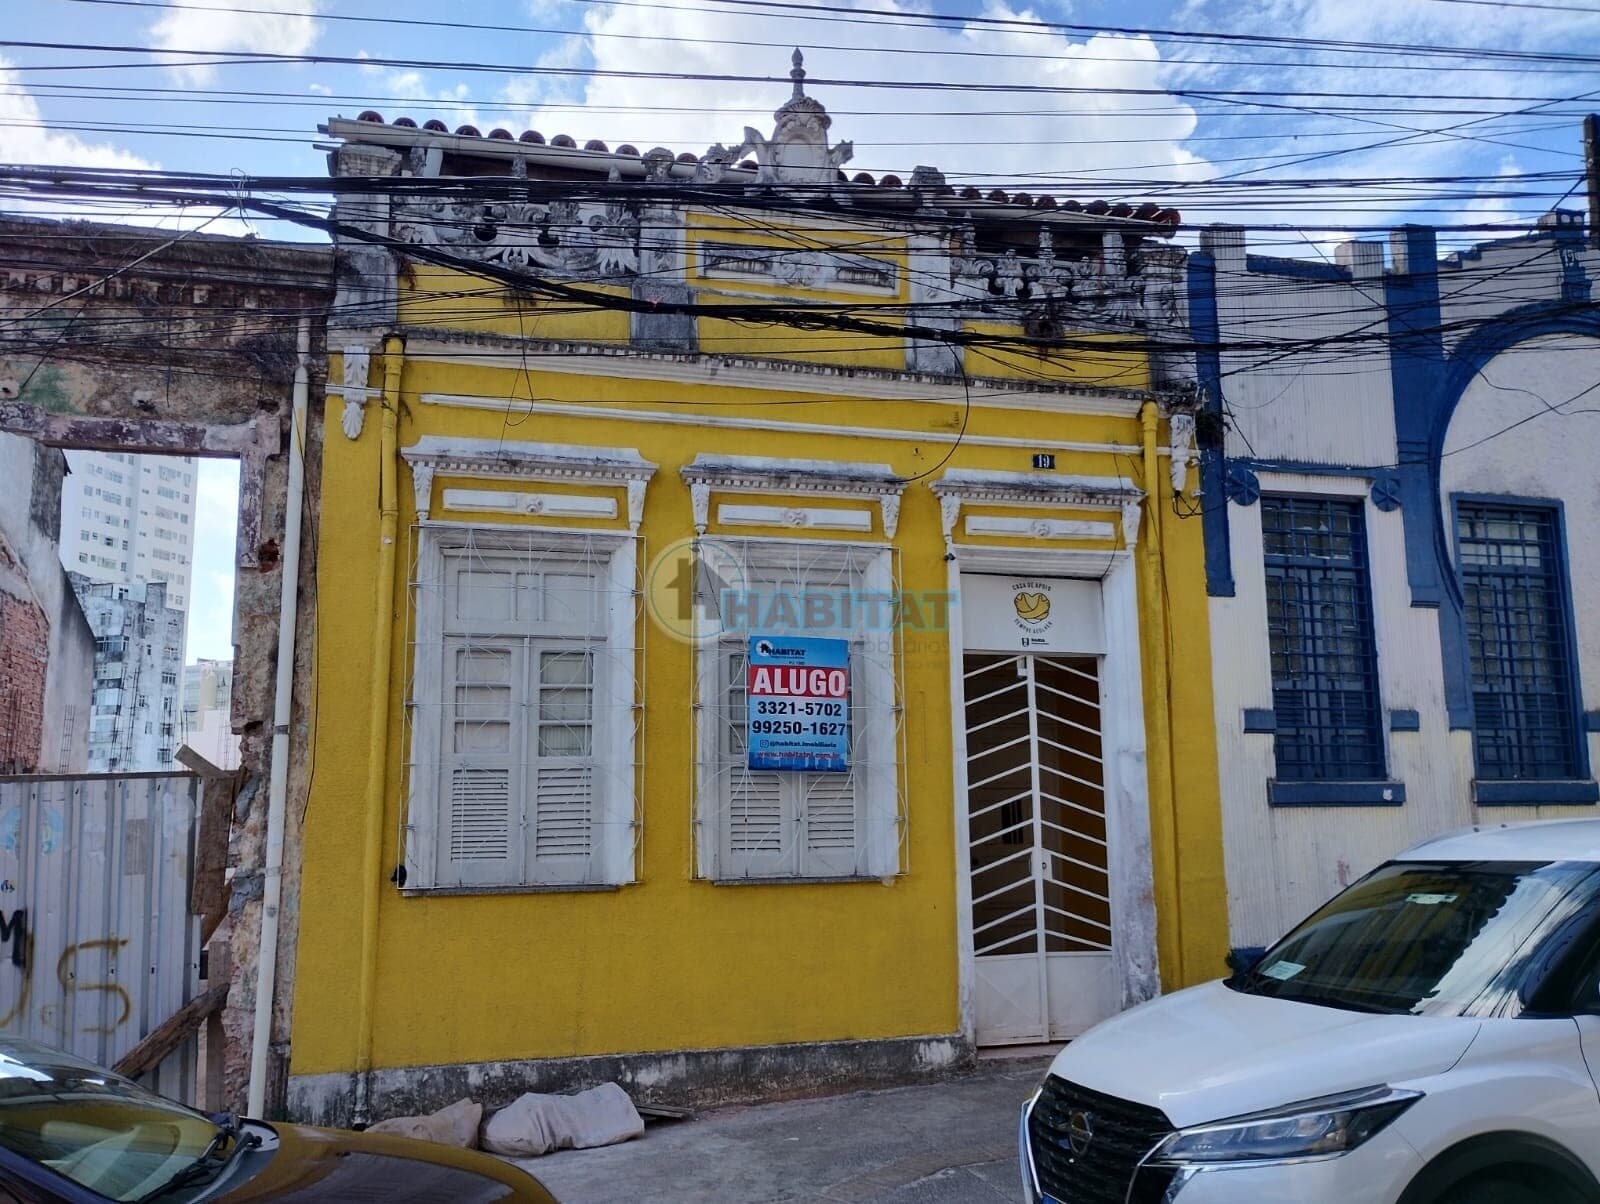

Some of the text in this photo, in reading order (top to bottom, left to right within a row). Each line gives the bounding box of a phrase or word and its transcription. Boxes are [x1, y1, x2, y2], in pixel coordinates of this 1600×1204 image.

[769, 648, 806, 656] HABITAT
[752, 668, 845, 696] ALUGO
[758, 701, 842, 716] 3321-5702
[752, 720, 846, 736] 99250-1627
